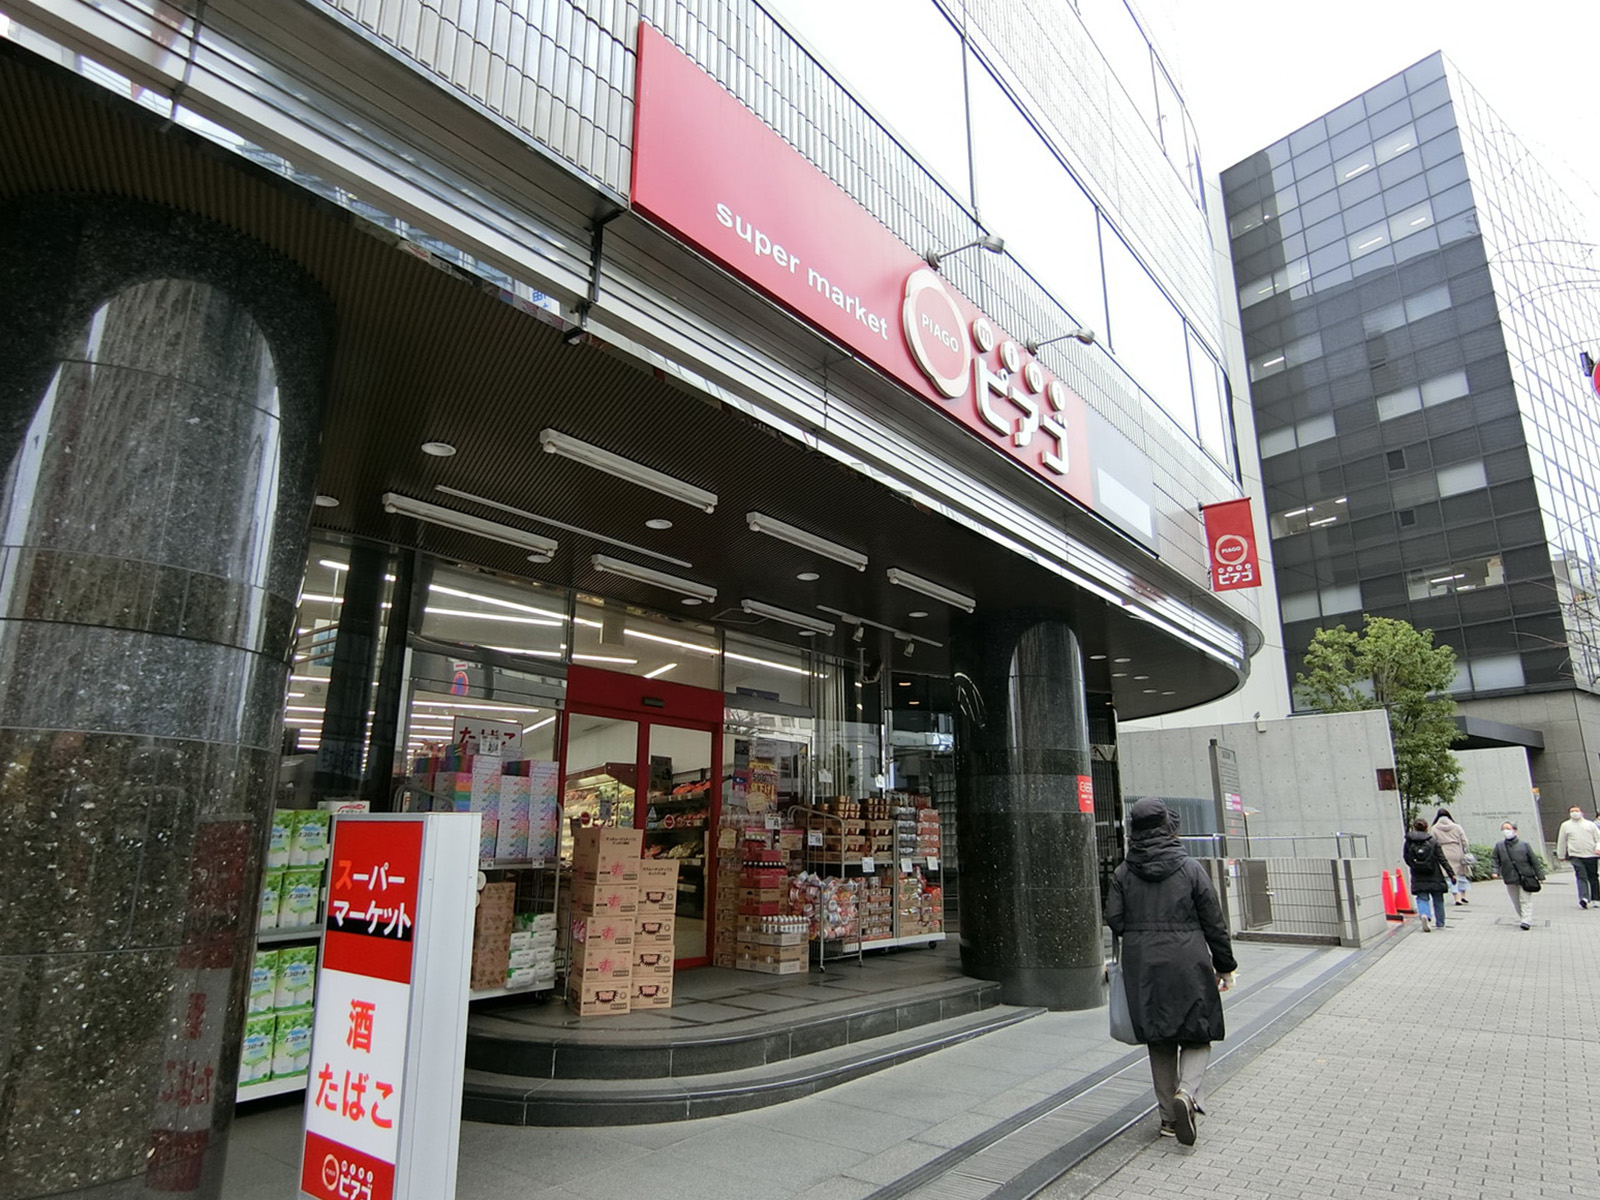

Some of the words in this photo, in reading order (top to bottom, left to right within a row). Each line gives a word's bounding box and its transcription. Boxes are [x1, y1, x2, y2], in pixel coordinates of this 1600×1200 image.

[715, 202, 800, 274] super
[807, 267, 889, 341] market
[921, 312, 959, 353] PIAGO
[974, 356, 1070, 475] ピアゴ
[1221, 545, 1242, 555] PIAGO
[1218, 567, 1253, 585] ピアゴ
[335, 860, 405, 891] スーパー
[333, 900, 412, 938] マーケット
[346, 998, 376, 1054] 酒
[315, 1062, 394, 1129] たばこ
